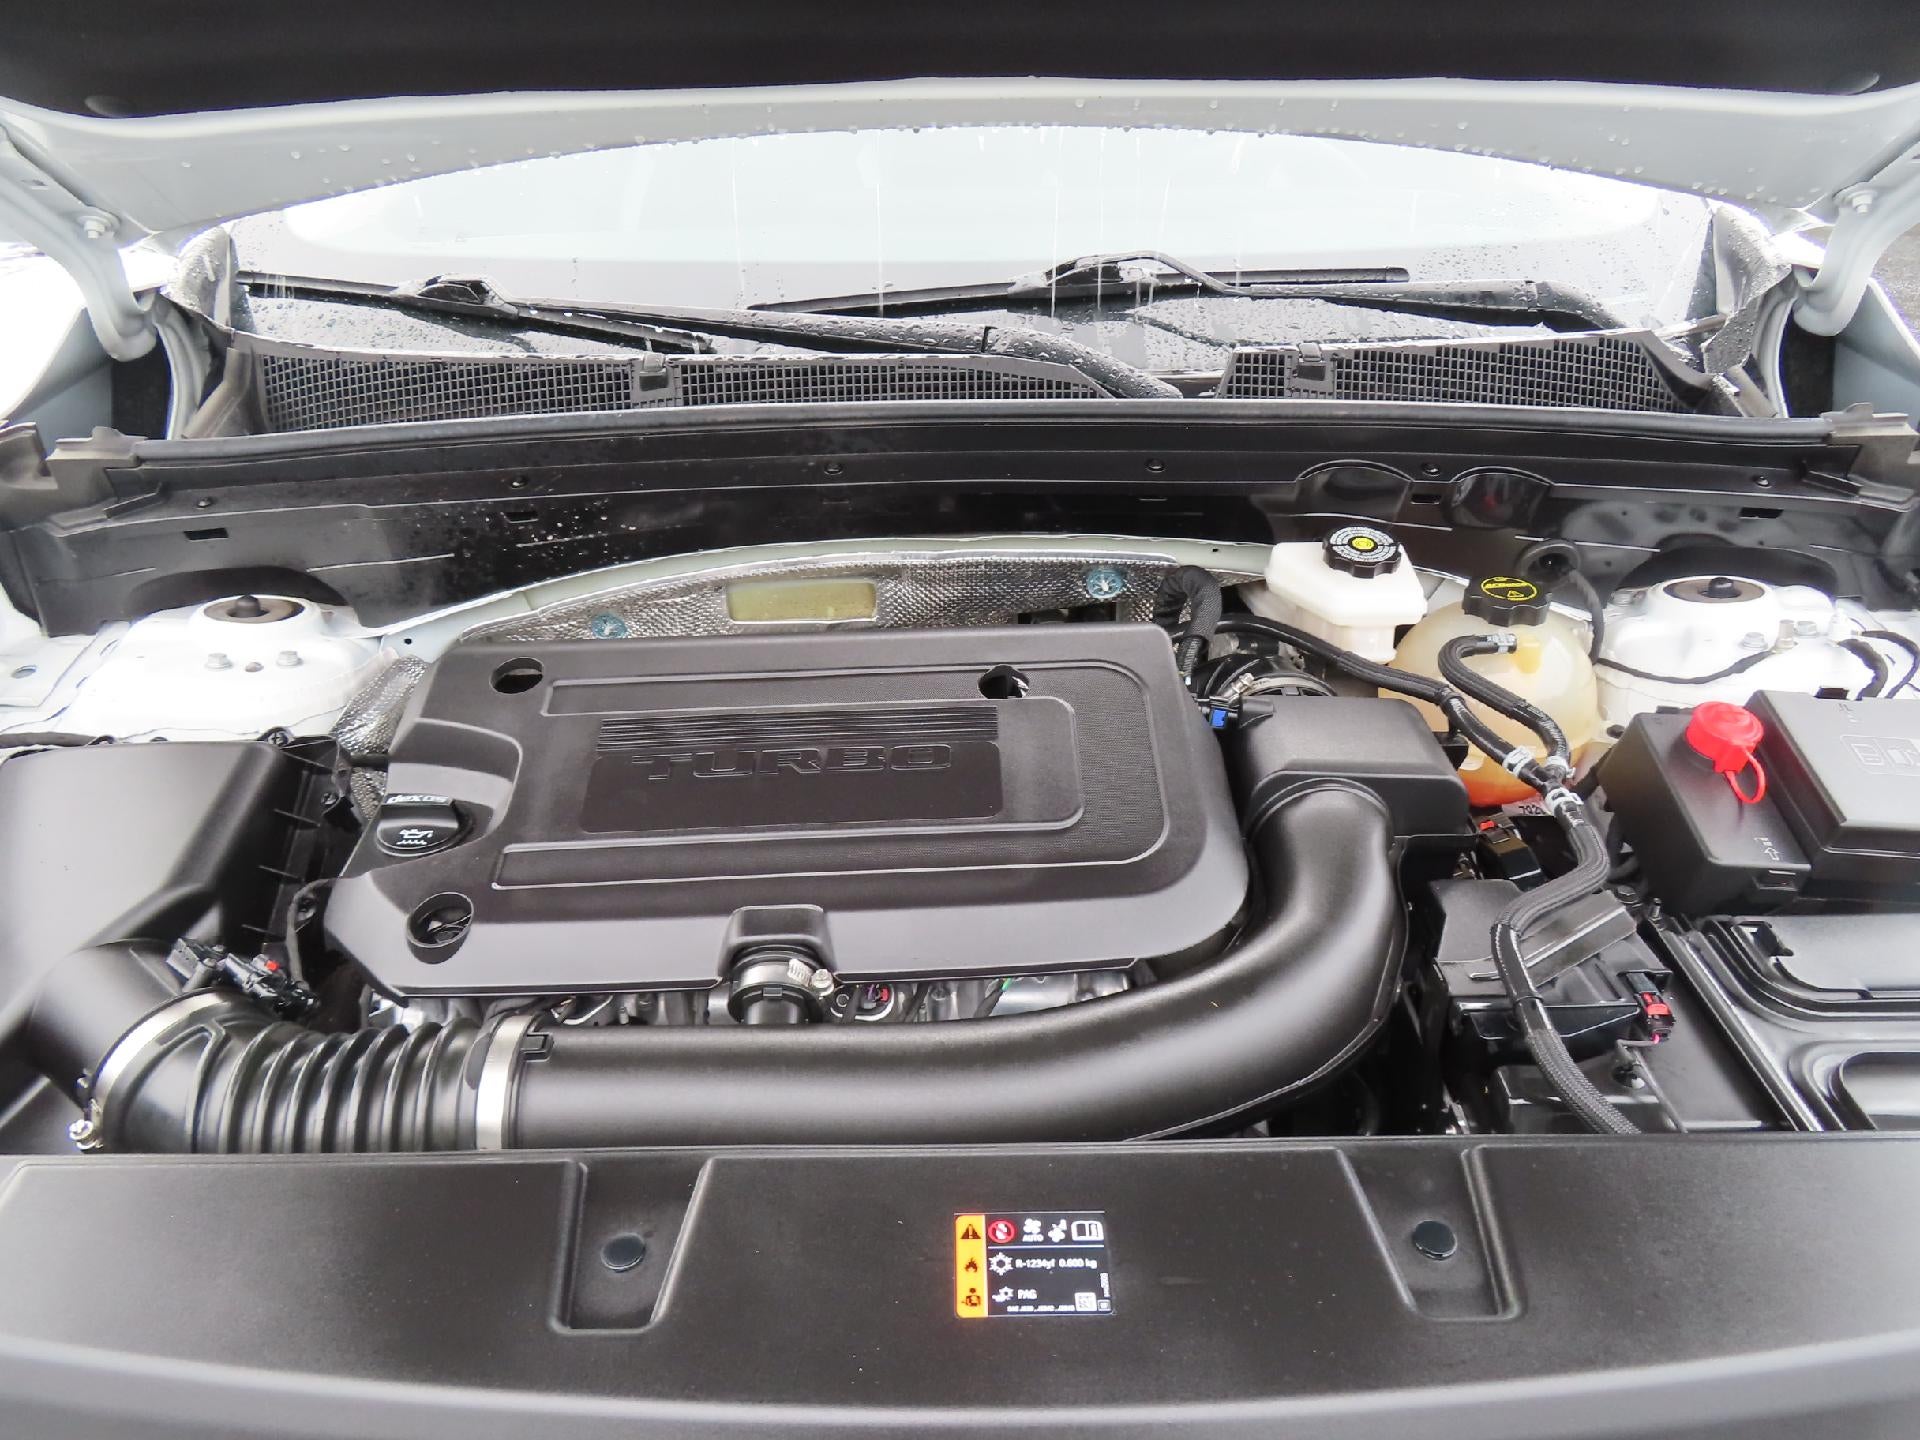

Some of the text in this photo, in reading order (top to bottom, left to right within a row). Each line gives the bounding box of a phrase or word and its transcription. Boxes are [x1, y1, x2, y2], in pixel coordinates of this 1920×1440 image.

[632, 743, 952, 781] TURBO
[1022, 1234, 1044, 1242] AUTO
[1085, 1258, 1097, 1269] kg
[1018, 1289, 1037, 1299] PAG
